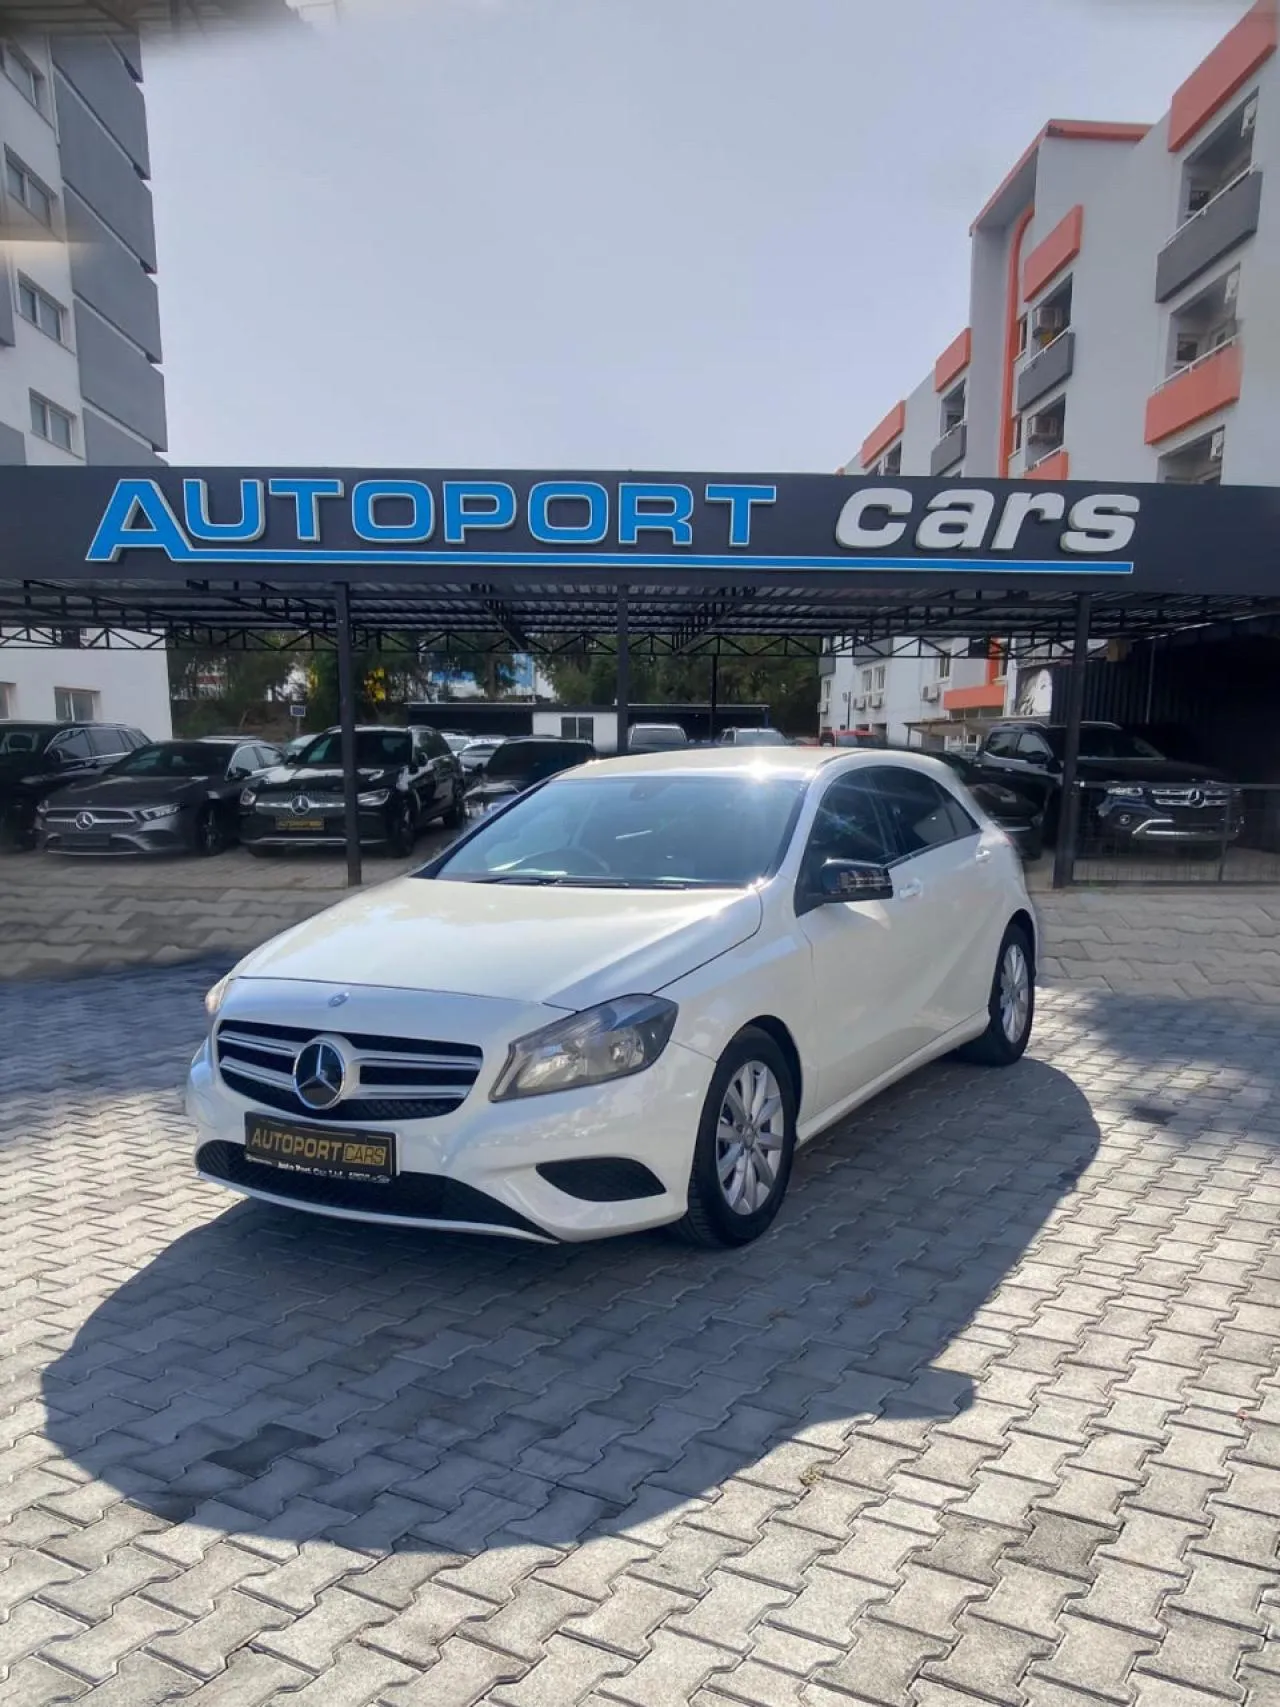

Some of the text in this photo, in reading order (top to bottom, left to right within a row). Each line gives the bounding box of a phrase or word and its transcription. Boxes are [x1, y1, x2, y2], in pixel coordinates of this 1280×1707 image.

[84, 477, 1141, 562] AUTOPORT cars
[251, 1127, 386, 1165] AUTOPORT CARS
